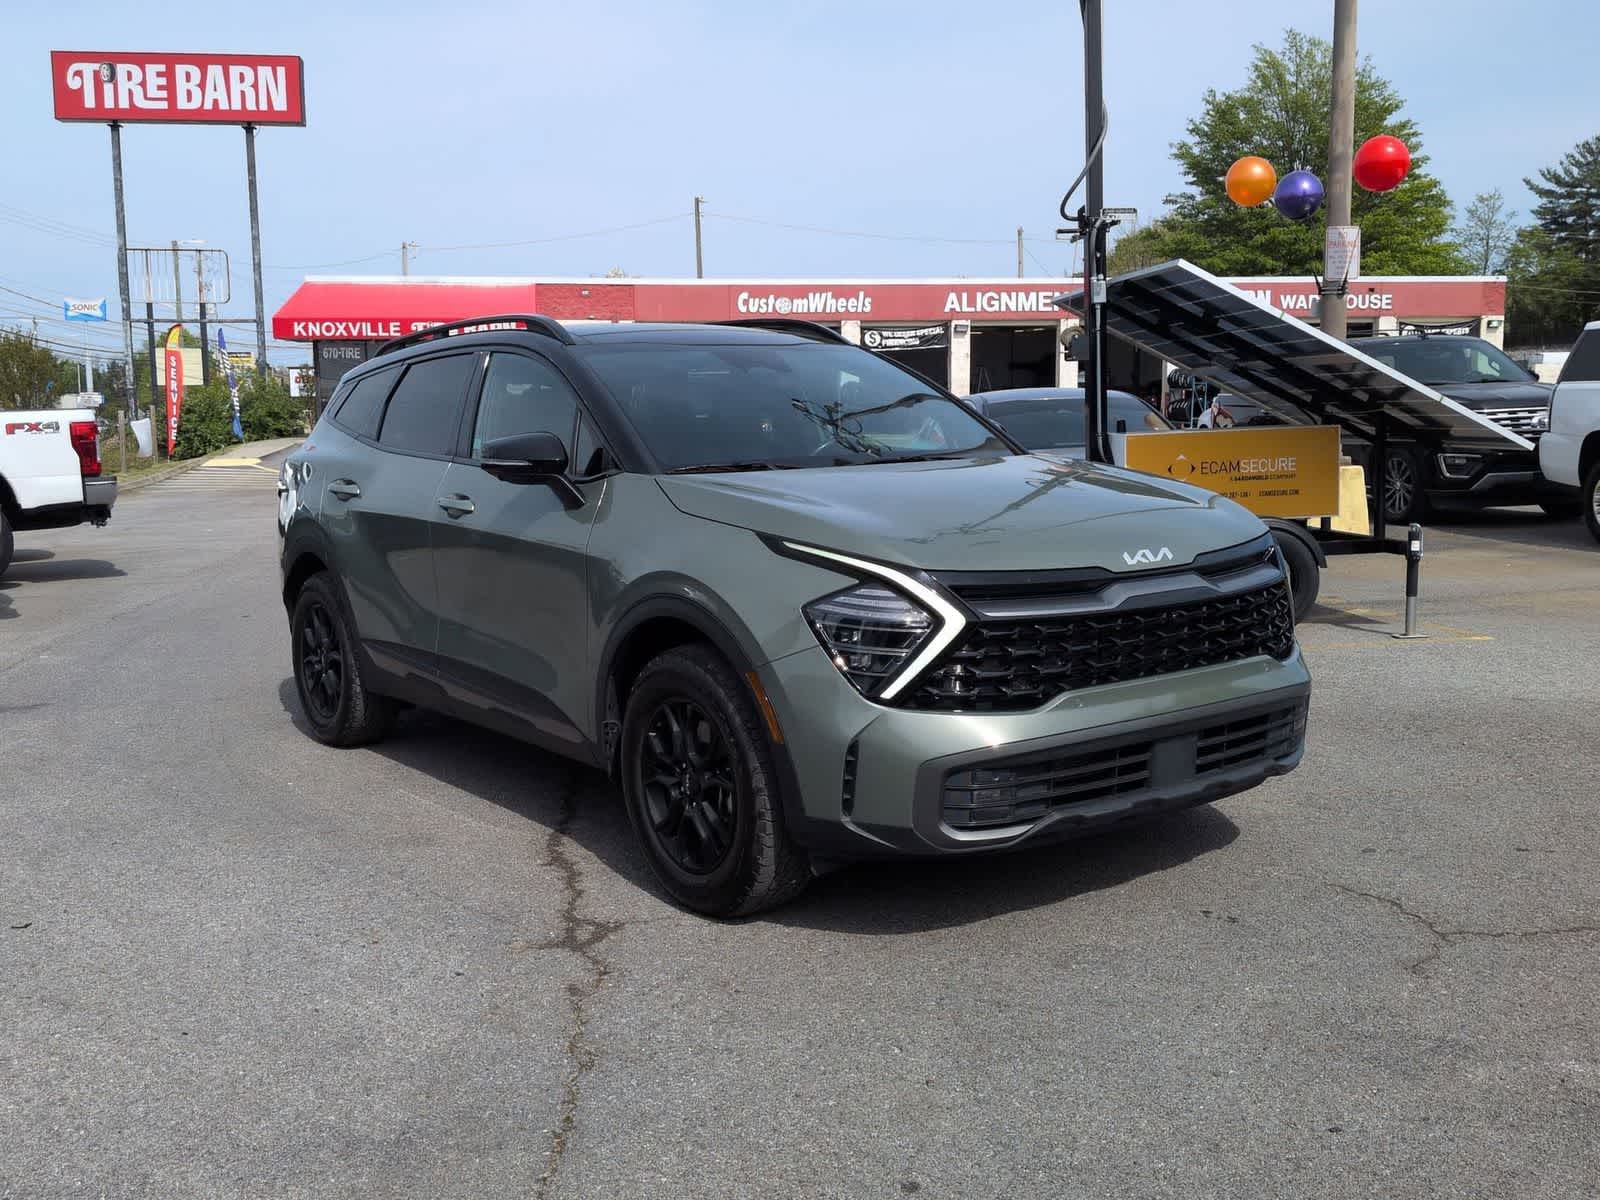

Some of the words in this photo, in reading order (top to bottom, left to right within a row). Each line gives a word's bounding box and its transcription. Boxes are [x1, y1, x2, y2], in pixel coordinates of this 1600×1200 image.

[174, 65, 287, 111] BARN
[71, 303, 98, 312] SONIC
[293, 321, 401, 337] KNOXVILLE
[322, 347, 361, 359] 670-TIRE
[169, 355, 179, 441] SERVICE
[5, 421, 60, 434] FX4
[1200, 457, 1297, 474] ECAMSECURE
[1122, 547, 1174, 565] KIA
